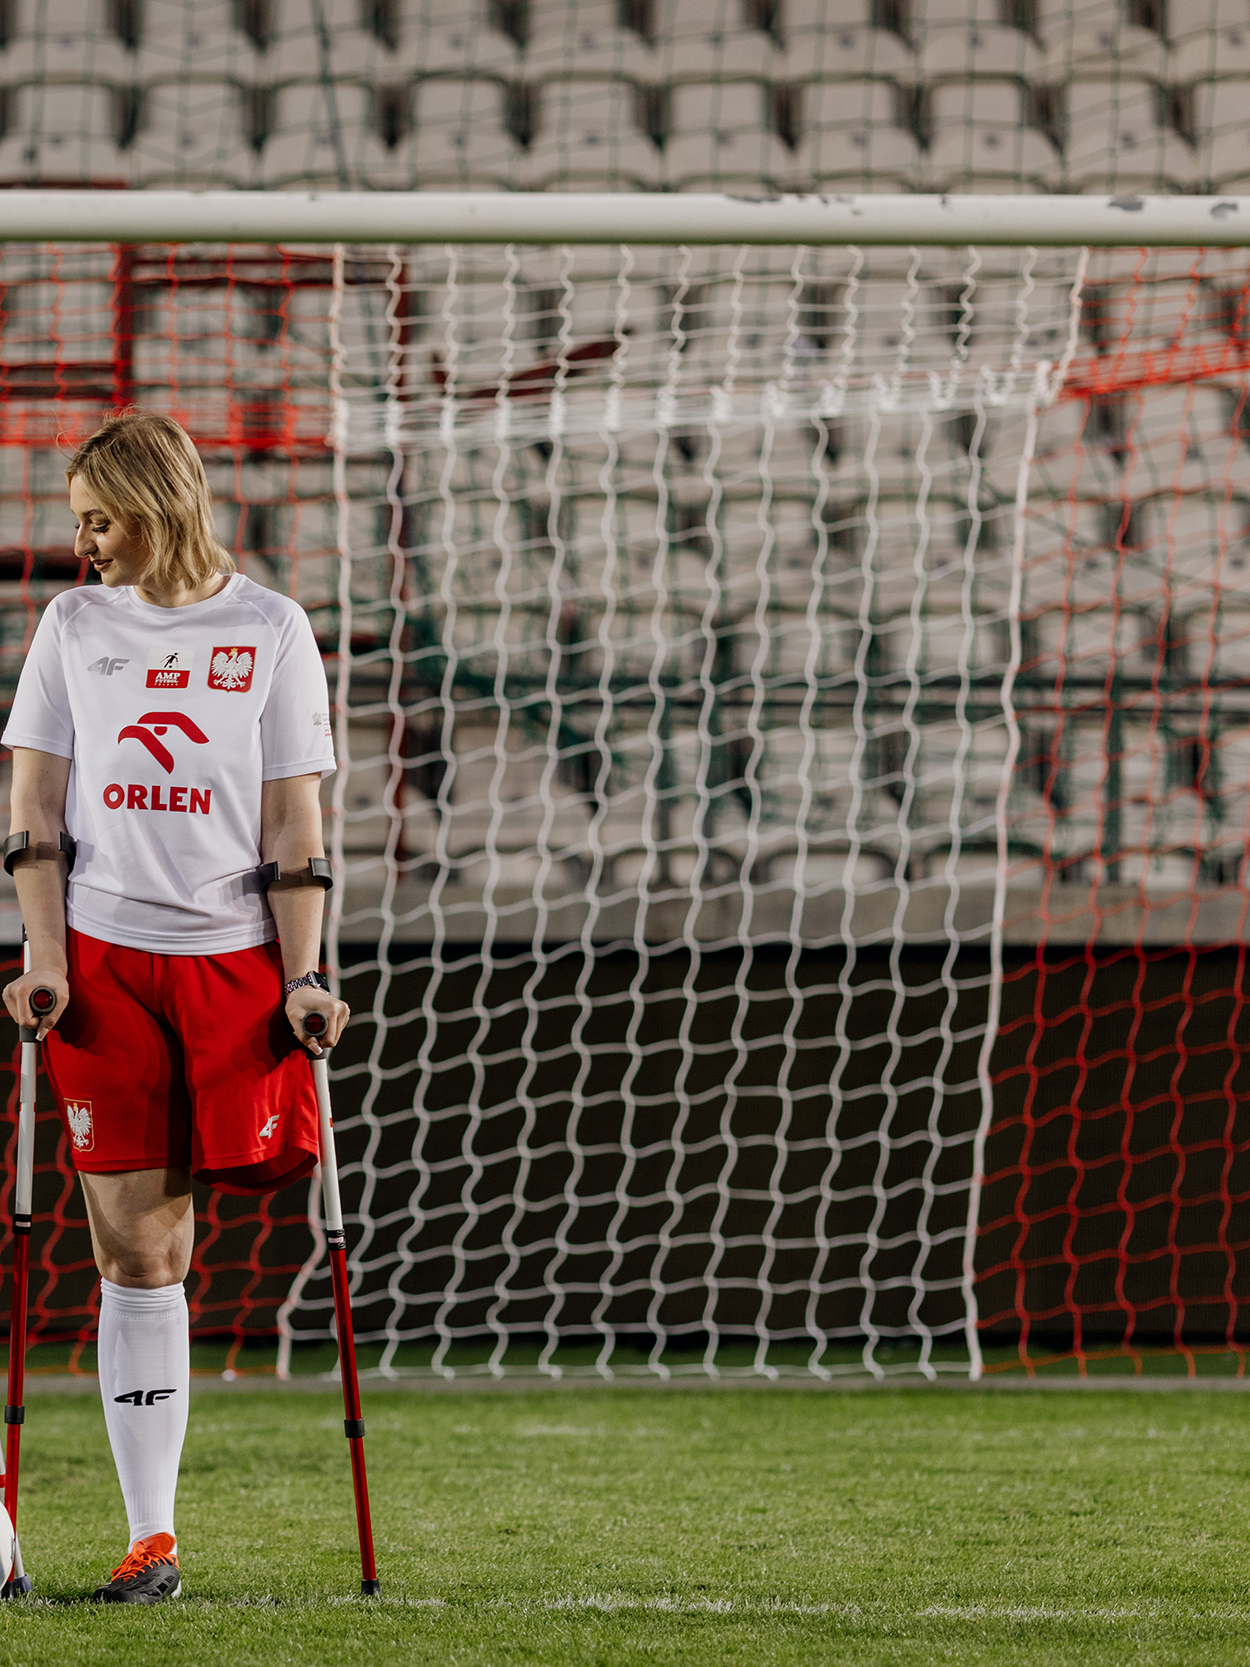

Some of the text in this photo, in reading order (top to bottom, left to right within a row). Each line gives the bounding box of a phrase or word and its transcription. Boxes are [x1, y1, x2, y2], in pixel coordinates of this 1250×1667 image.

[87, 656, 130, 675] 4F
[155, 672, 181, 680] AMP
[103, 783, 212, 815] ORLEN
[259, 1114, 280, 1139] 4F
[113, 1388, 177, 1406] 4F
